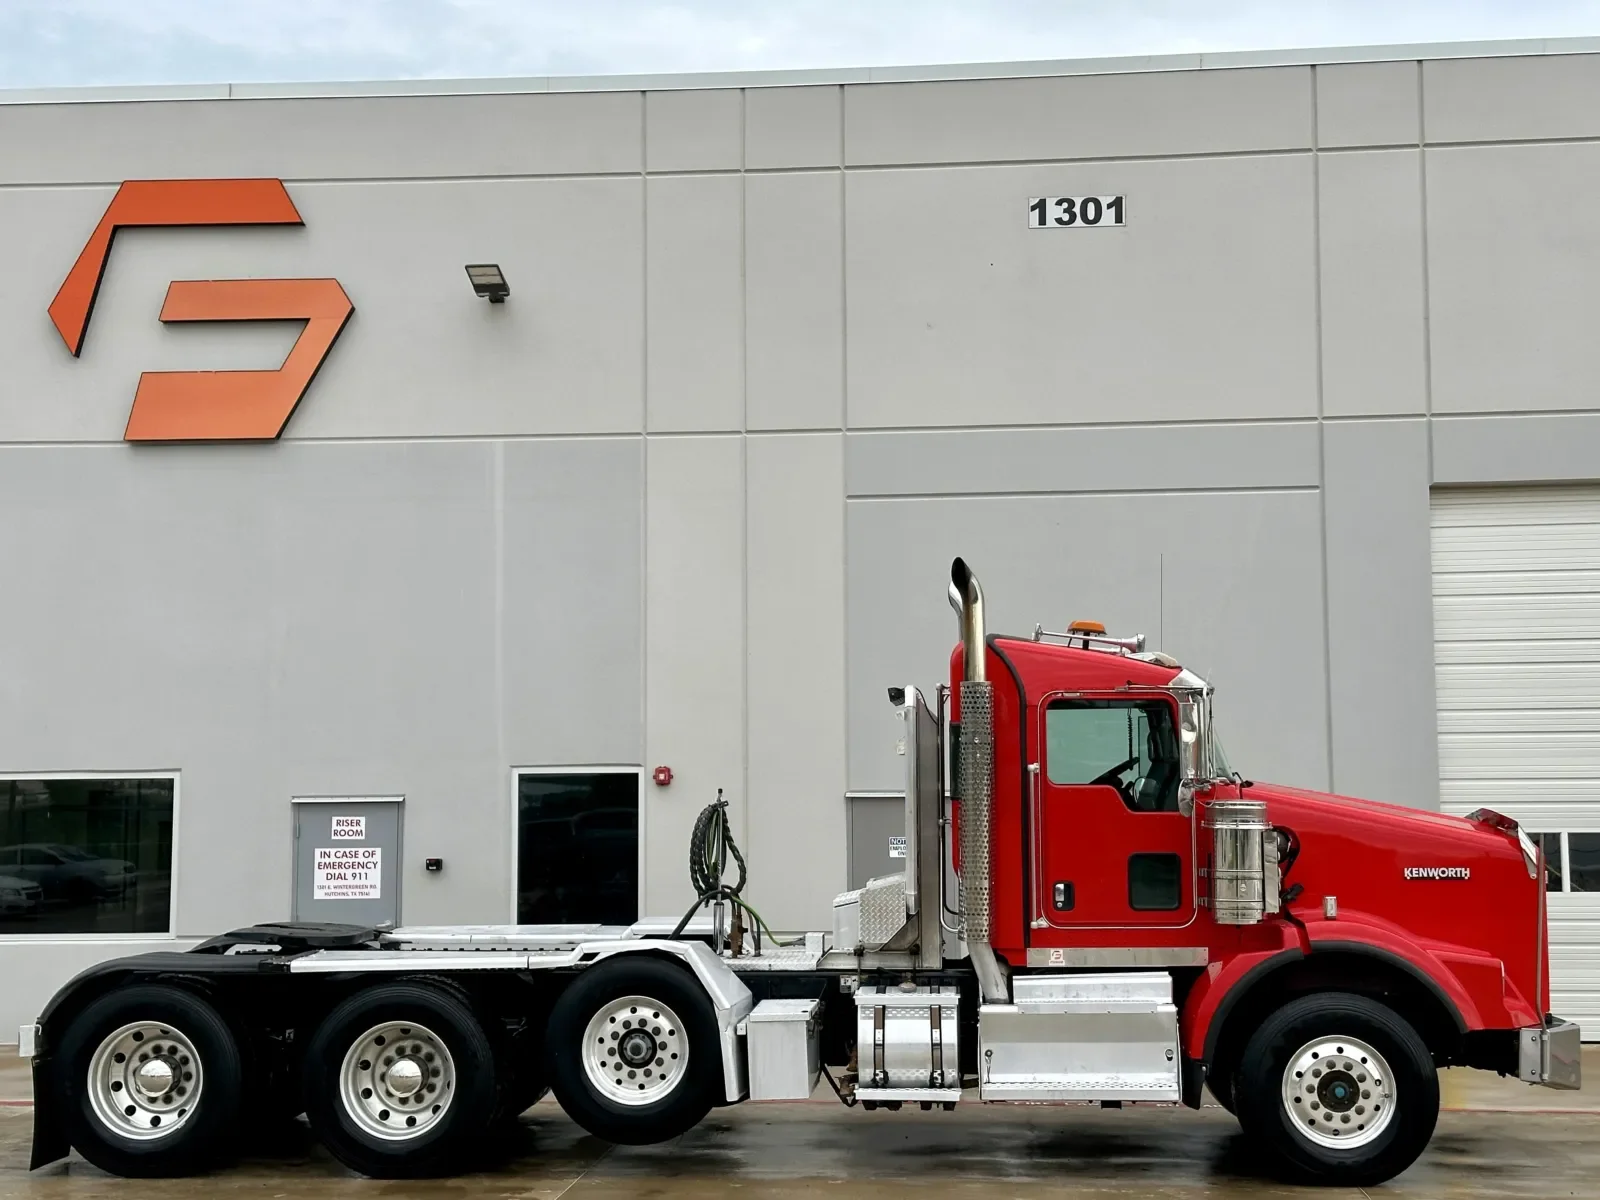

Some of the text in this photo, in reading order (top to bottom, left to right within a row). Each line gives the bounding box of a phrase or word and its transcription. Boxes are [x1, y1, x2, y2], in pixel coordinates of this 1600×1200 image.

[1030, 196, 1123, 226] 1301
[336, 819, 361, 827] RISER
[333, 829, 363, 837] ROOM
[320, 850, 376, 859] IN CASE OF
[317, 861, 378, 870] EMERGENCY
[326, 872, 368, 880] DIAL 911
[1404, 867, 1470, 878] KENWORTH
